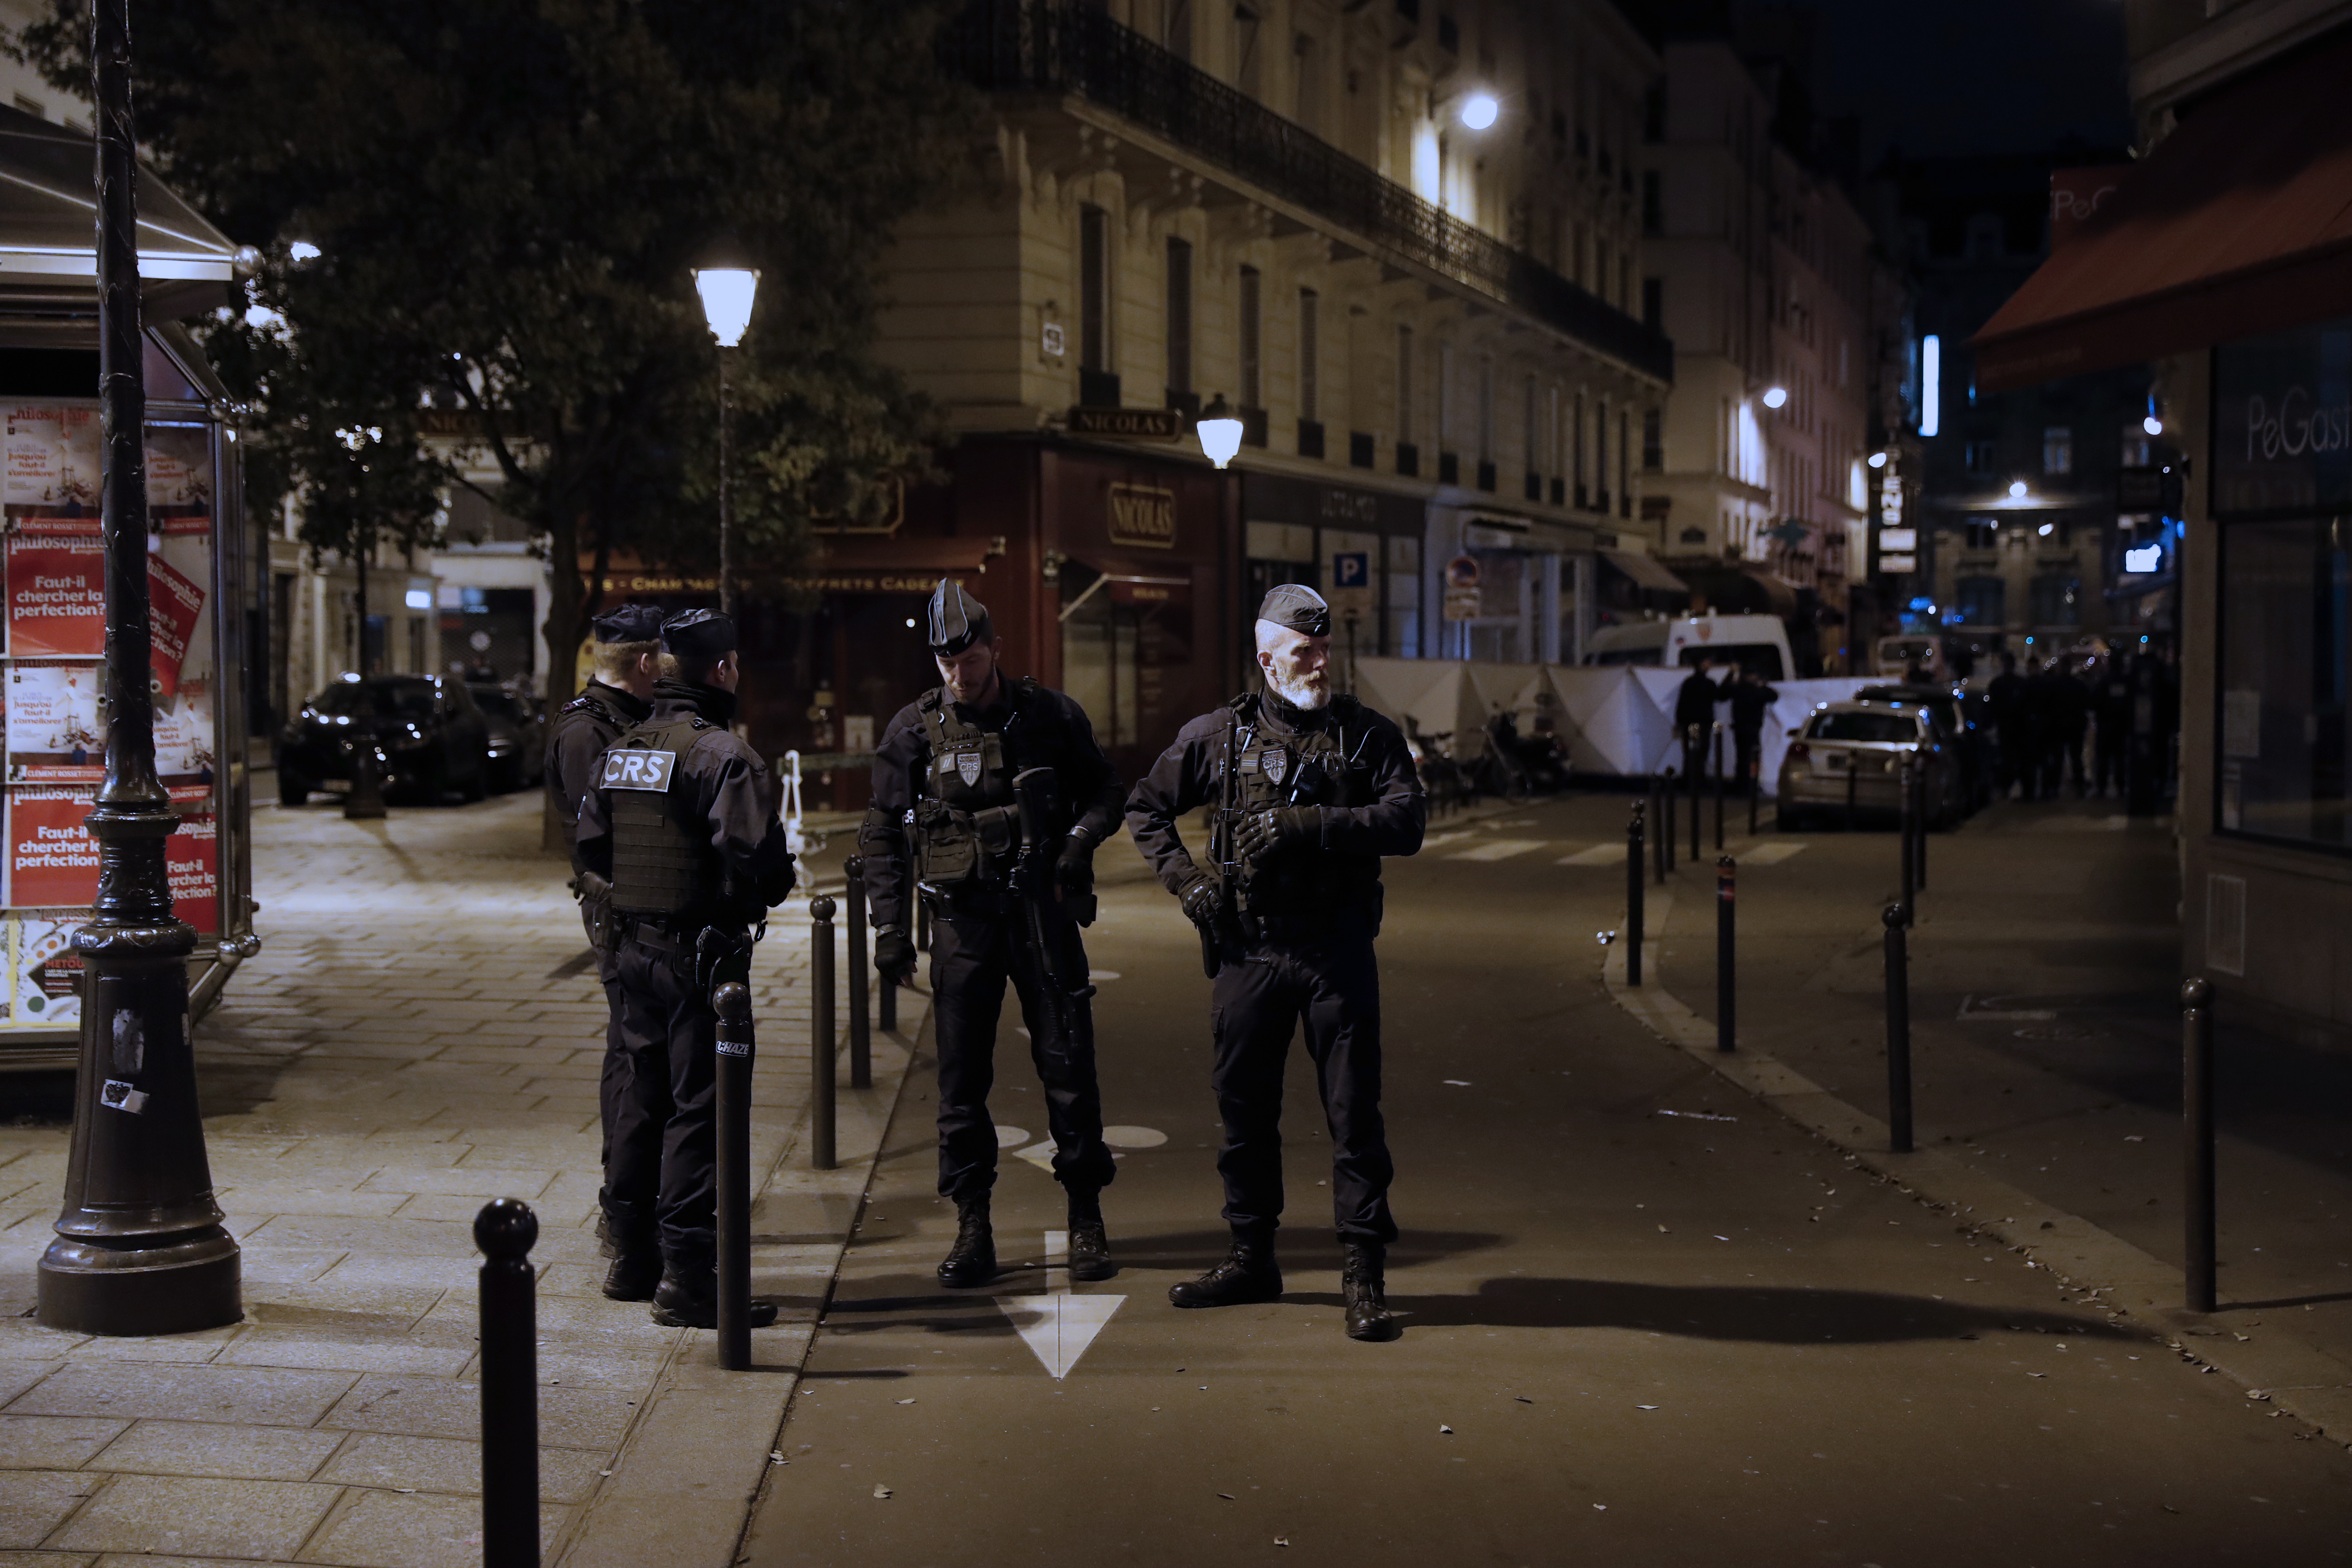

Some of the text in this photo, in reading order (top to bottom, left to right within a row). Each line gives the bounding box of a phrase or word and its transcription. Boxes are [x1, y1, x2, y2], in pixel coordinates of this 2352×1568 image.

[1080, 413, 1168, 433] NICOLAS
[1112, 496, 1174, 536] NICOLAS
[1342, 557, 1359, 583] P
[34, 575, 86, 588] Faut-il
[147, 556, 201, 608] hilosophie
[16, 589, 103, 603] chercher la
[14, 602, 105, 621] perfection?
[149, 605, 178, 631] aut-il
[604, 755, 665, 783] CRS
[960, 763, 978, 772] CRS
[1263, 758, 1285, 769] CRS
[38, 826, 88, 839] Faut-il
[18, 840, 87, 853] chercher
[16, 854, 100, 871] perfection
[167, 859, 203, 873] Faut-il
[168, 871, 215, 887] ercher la
